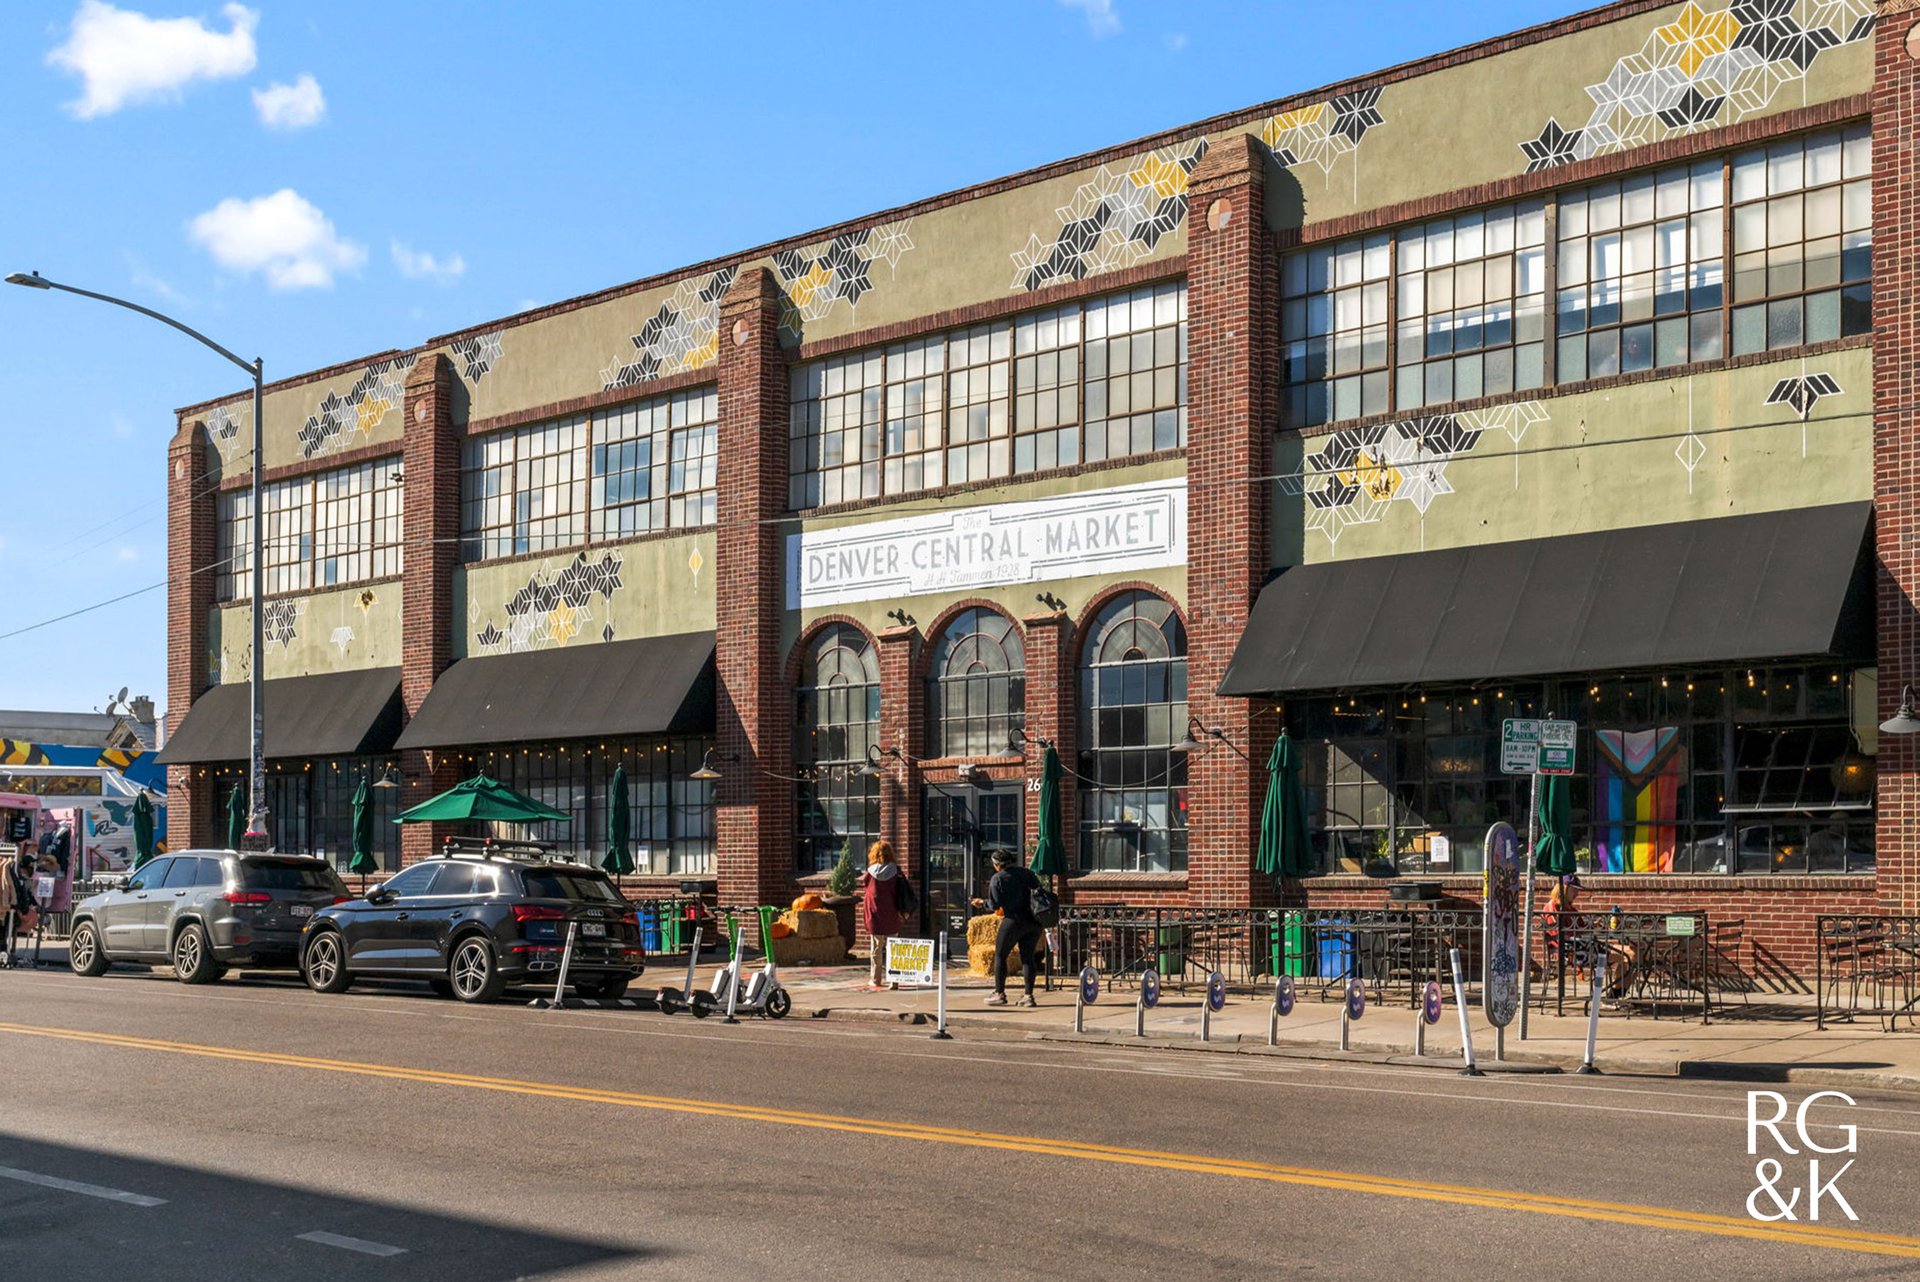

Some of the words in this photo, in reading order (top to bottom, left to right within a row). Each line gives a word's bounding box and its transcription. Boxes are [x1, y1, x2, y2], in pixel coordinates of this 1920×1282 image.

[962, 516, 982, 530] The
[809, 544, 899, 584] DENVER
[911, 527, 1029, 570] CENTRAL
[1045, 508, 1160, 555] MARKET
[950, 568, 993, 584] Tammen
[996, 563, 1020, 578] 1928
[1505, 724, 1512, 739] 2
[1520, 722, 1531, 732] HR
[1513, 731, 1538, 740] PARKING
[890, 943, 930, 959] VINTAGE
[890, 956, 929, 972] MARKET
